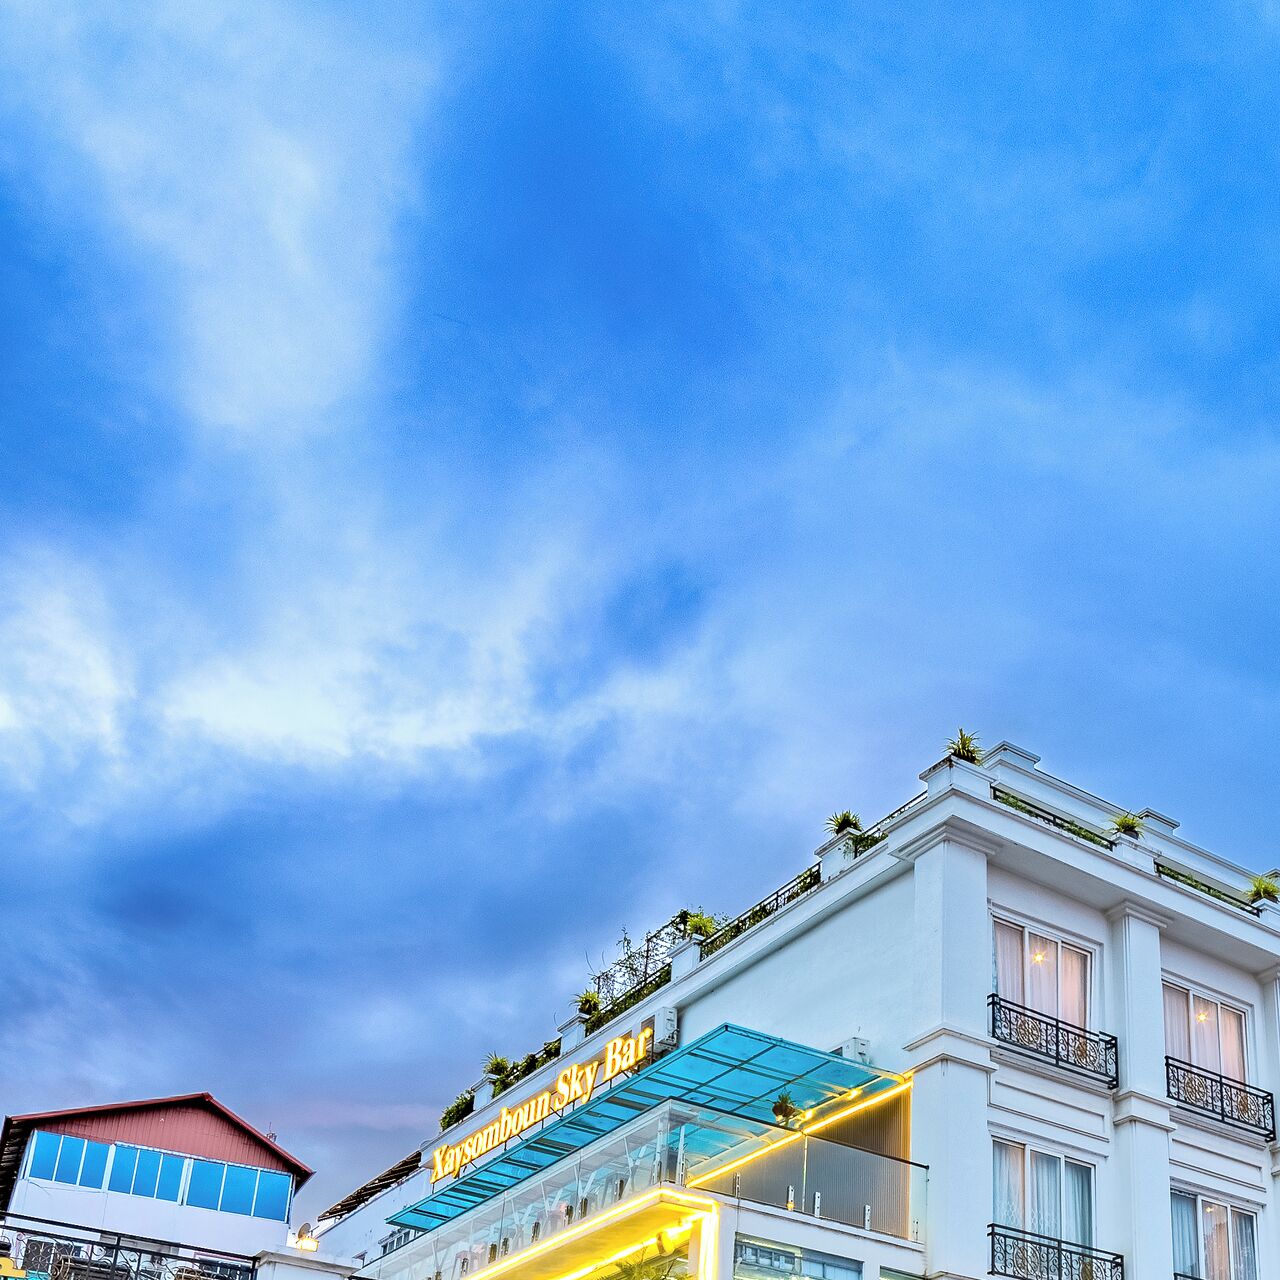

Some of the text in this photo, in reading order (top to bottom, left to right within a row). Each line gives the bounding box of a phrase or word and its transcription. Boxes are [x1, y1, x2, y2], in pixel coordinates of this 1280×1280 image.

[430, 1027, 653, 1184] Xaysomboun Sky Bar
